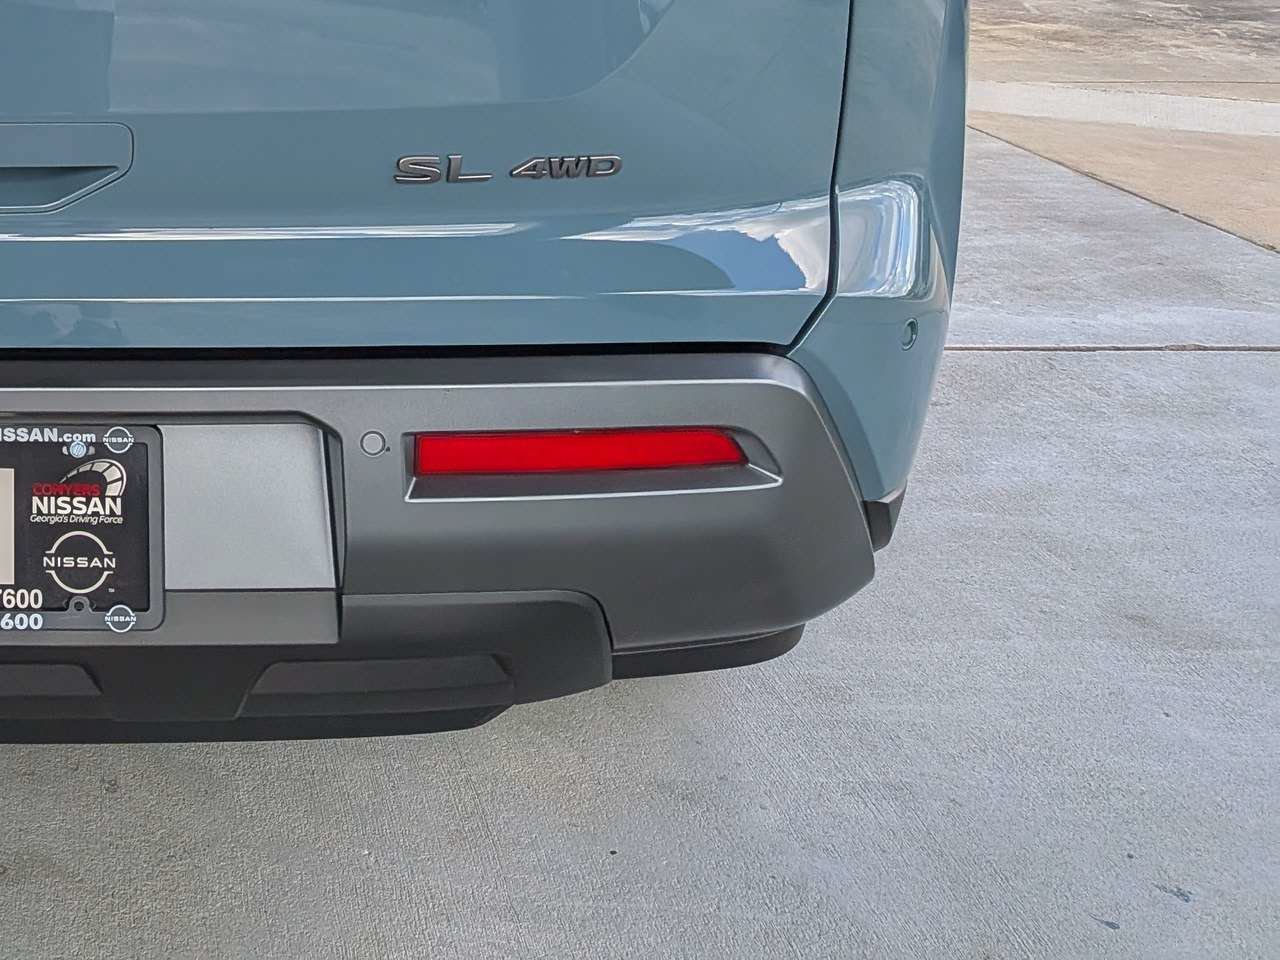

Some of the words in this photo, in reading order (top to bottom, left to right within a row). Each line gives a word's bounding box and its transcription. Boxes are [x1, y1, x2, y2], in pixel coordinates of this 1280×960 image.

[393, 154, 493, 184] SL
[509, 155, 623, 180] 4WD
[102, 436, 135, 444] NISSAN
[32, 483, 102, 496] CONYERS
[31, 496, 122, 516] NISSAN
[30, 514, 69, 525] Georgia's
[69, 515, 98, 526] Driving
[99, 515, 124, 524] Force
[42, 556, 116, 569] NISSAN
[104, 615, 138, 623] NISSAN
